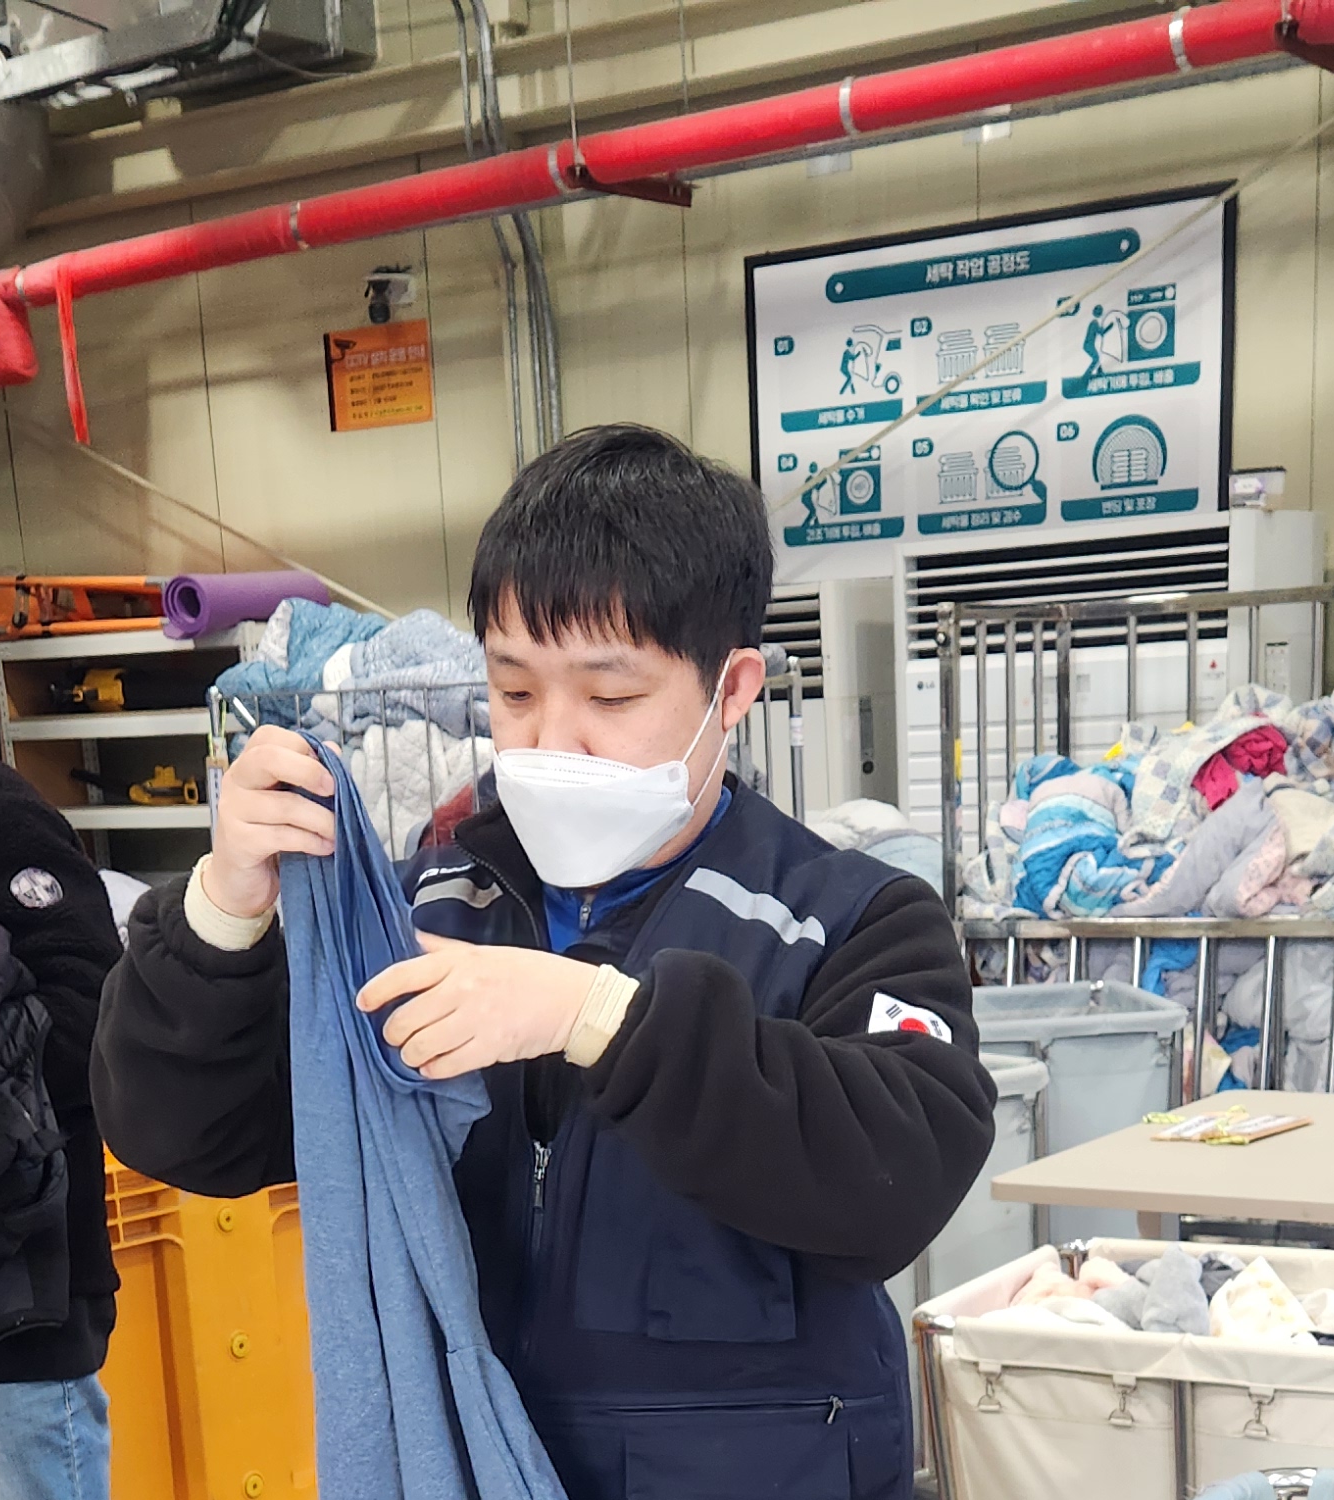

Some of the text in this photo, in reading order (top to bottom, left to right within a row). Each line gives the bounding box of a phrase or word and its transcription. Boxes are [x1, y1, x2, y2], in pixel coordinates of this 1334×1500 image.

[926, 251, 1031, 285] 세탁 작업 공정도
